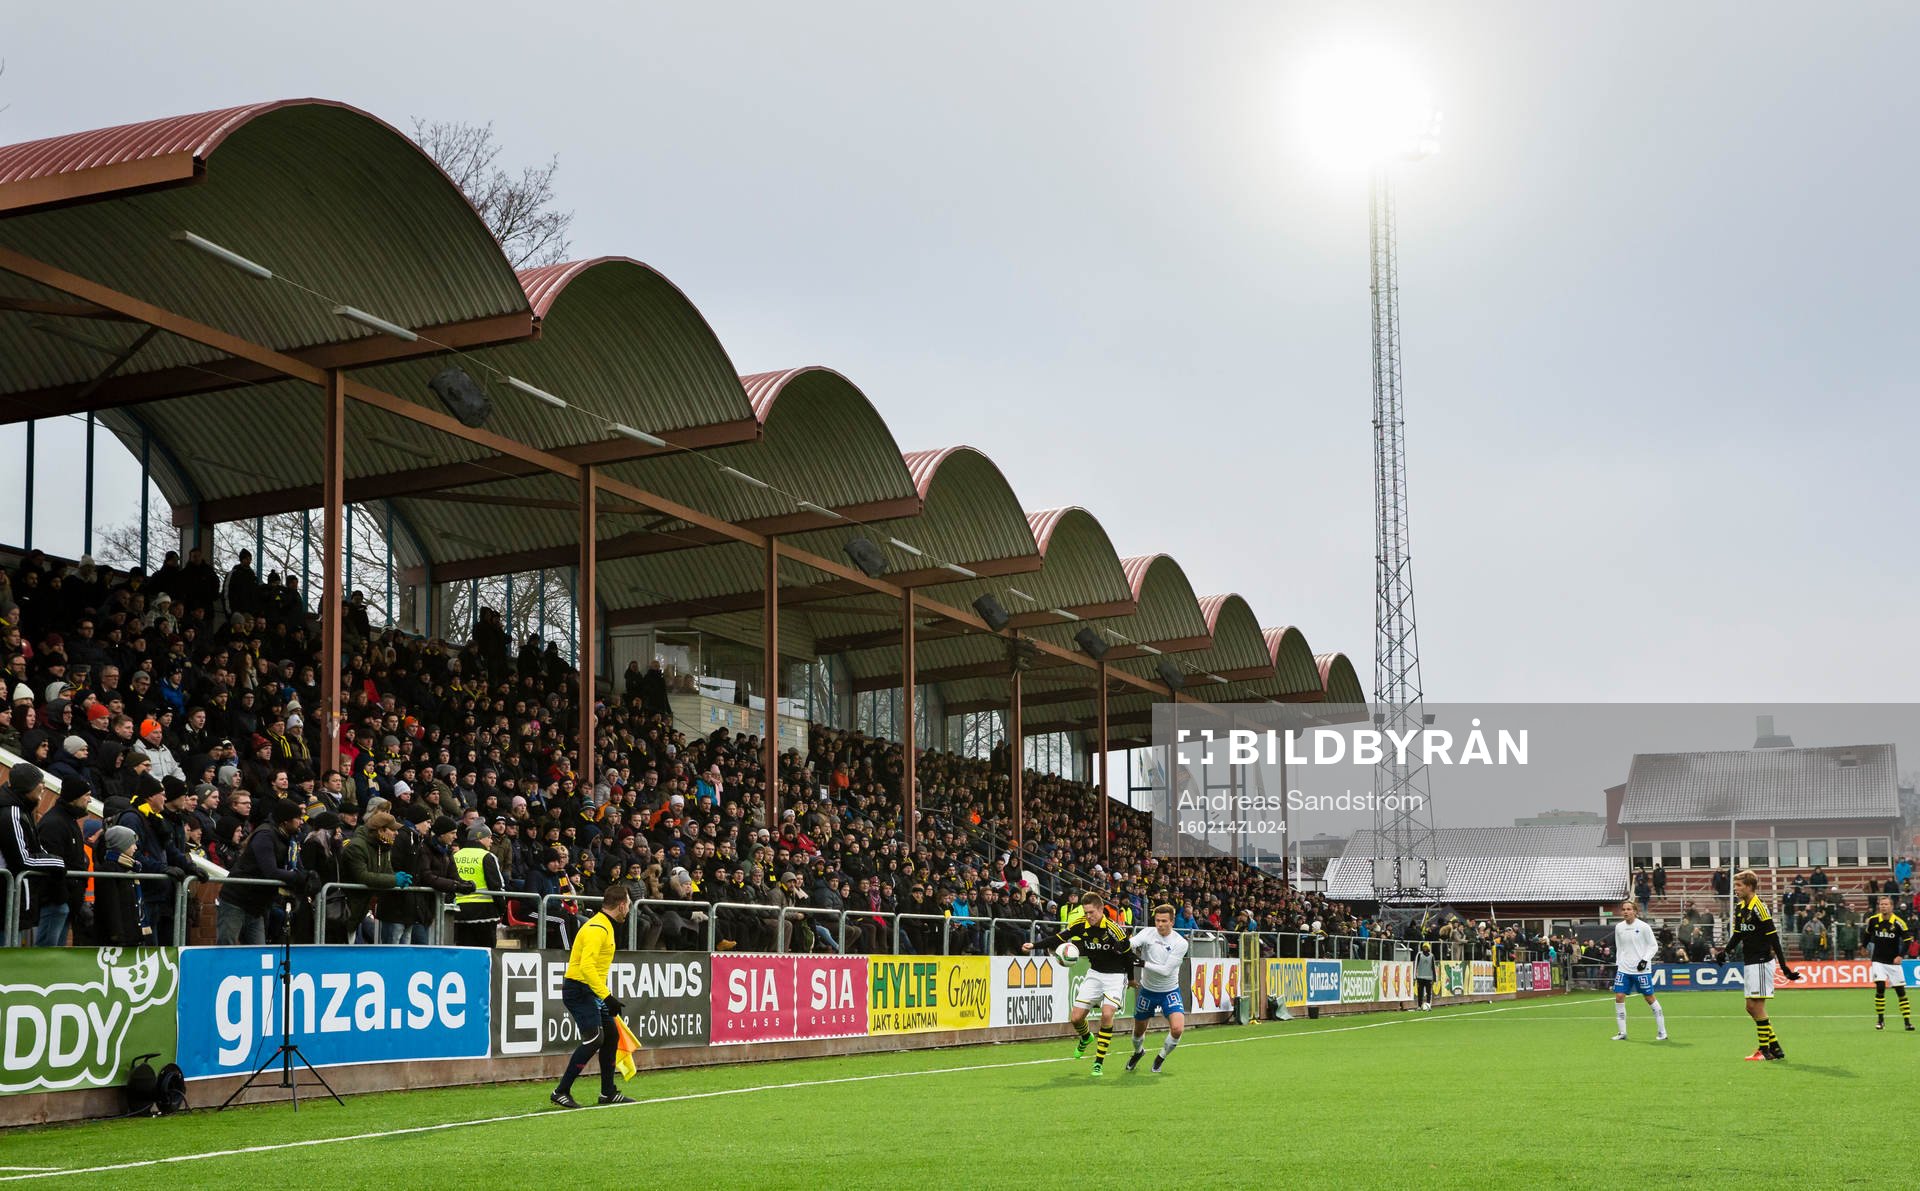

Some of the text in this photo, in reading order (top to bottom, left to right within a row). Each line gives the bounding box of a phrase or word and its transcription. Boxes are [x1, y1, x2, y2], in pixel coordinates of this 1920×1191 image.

[455, 856, 479, 864] UBLIK
[548, 961, 703, 1000] ETRANDS
[727, 968, 780, 1013] SIA
[811, 968, 855, 1011] SIA
[873, 962, 937, 1009] HYLTE
[1310, 967, 1338, 998] ginza.se
[1652, 967, 1745, 986] MECA
[1793, 965, 1873, 983] SYNSA
[948, 965, 987, 1020] Genzo
[1007, 990, 1053, 1025] EKSJÖHUS
[215, 954, 466, 1066] ginza.se
[639, 1010, 703, 1038] FÖNSTER
[727, 1017, 780, 1029] GLASS
[811, 1014, 855, 1025] GLASS
[873, 1012, 938, 1031] JAKT & LANTMAN
[0, 1001, 122, 1070] DDY
